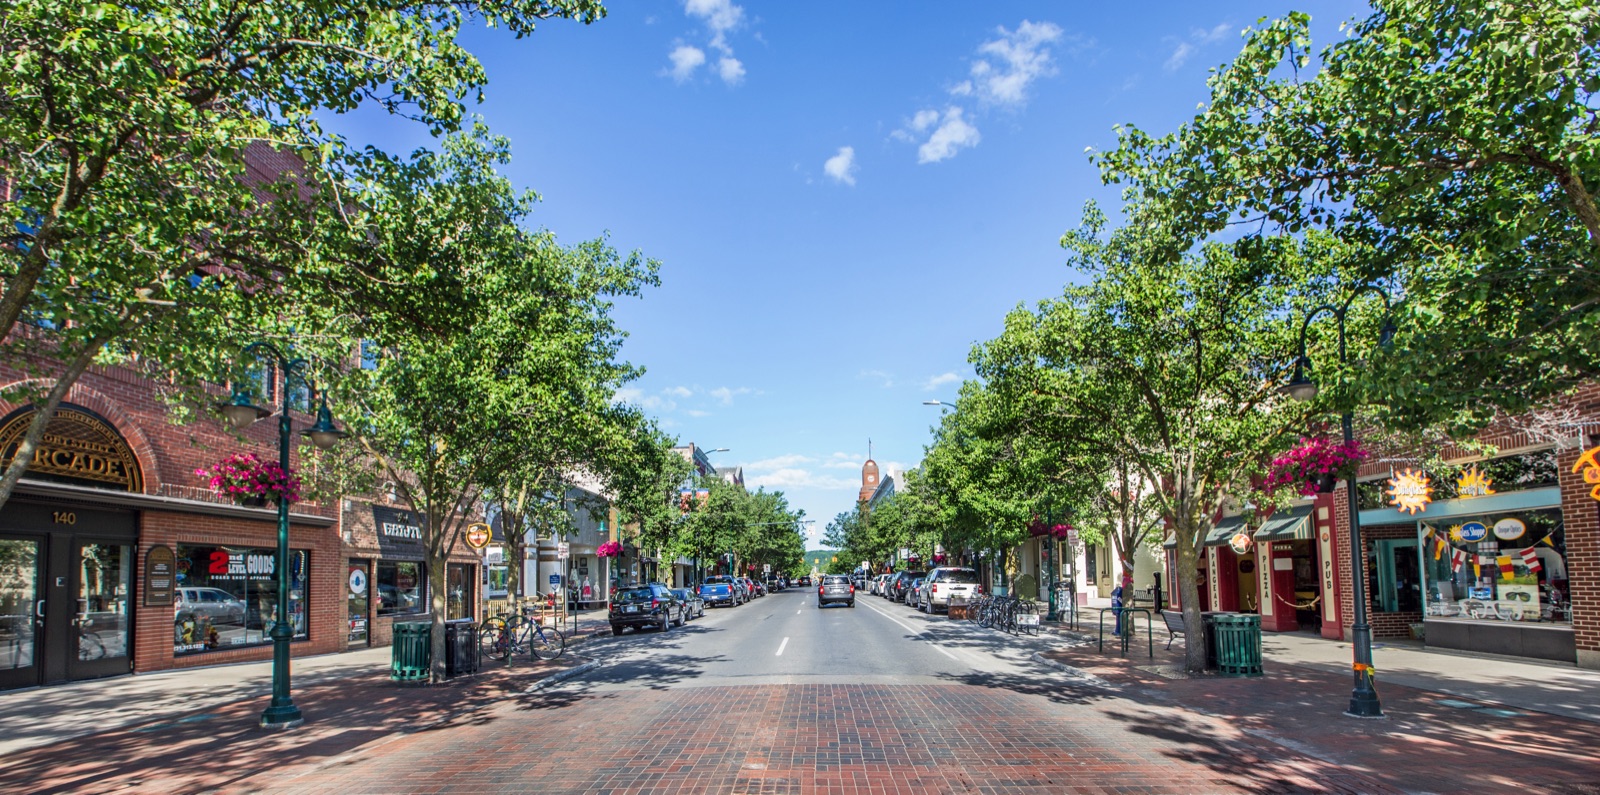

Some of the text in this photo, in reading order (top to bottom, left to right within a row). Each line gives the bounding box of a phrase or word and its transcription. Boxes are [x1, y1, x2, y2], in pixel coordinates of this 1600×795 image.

[53, 511, 76, 525] 140
[209, 551, 275, 574] 2nd LEVEL GOODS
[1324, 560, 1332, 590] PUB
